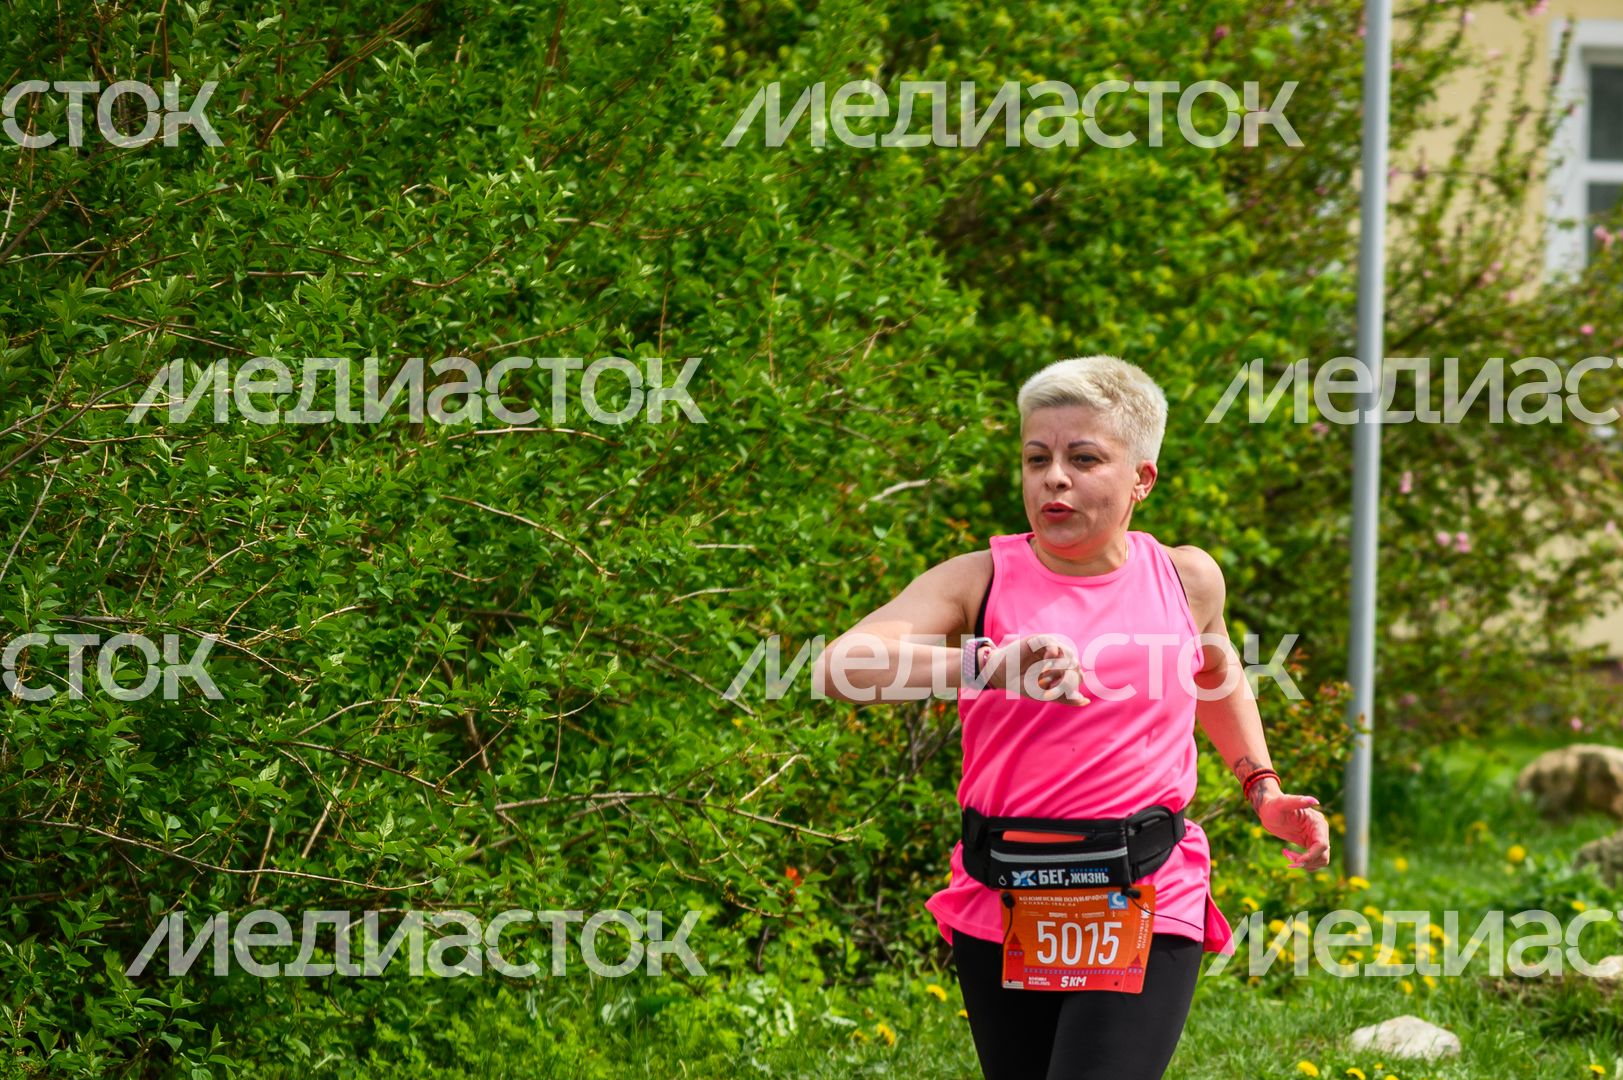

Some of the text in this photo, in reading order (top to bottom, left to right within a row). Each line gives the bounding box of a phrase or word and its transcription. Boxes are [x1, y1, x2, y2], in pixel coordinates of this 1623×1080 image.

[1038, 869, 1069, 886] БЕГ,
[1070, 872, 1109, 884] ЖИЗНЬ
[1036, 921, 1122, 966] 5015
